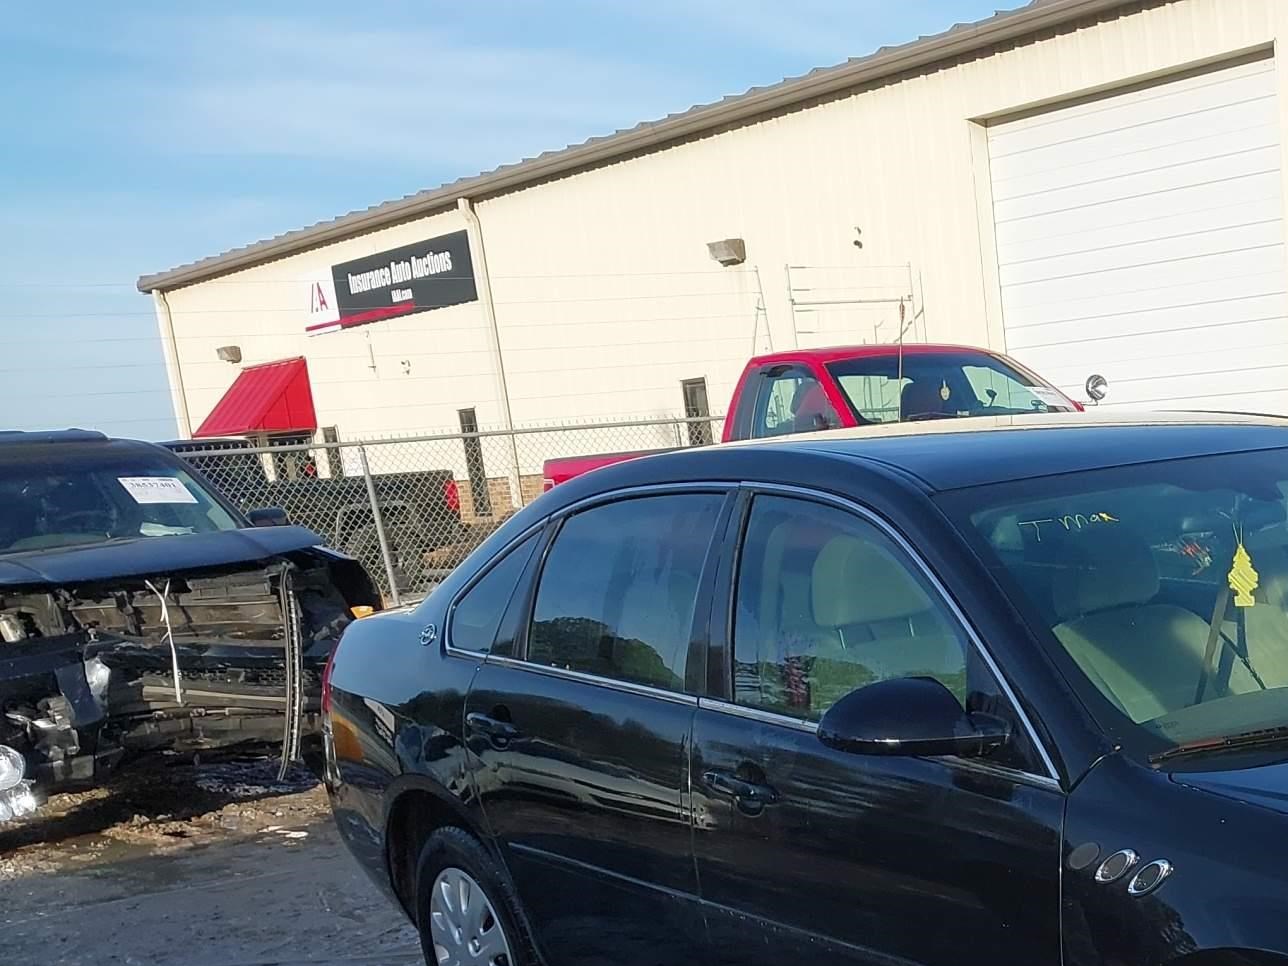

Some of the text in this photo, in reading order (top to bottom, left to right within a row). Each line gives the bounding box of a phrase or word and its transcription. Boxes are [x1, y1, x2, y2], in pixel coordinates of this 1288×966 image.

[347, 251, 453, 295] Insurance Auto Auctions
